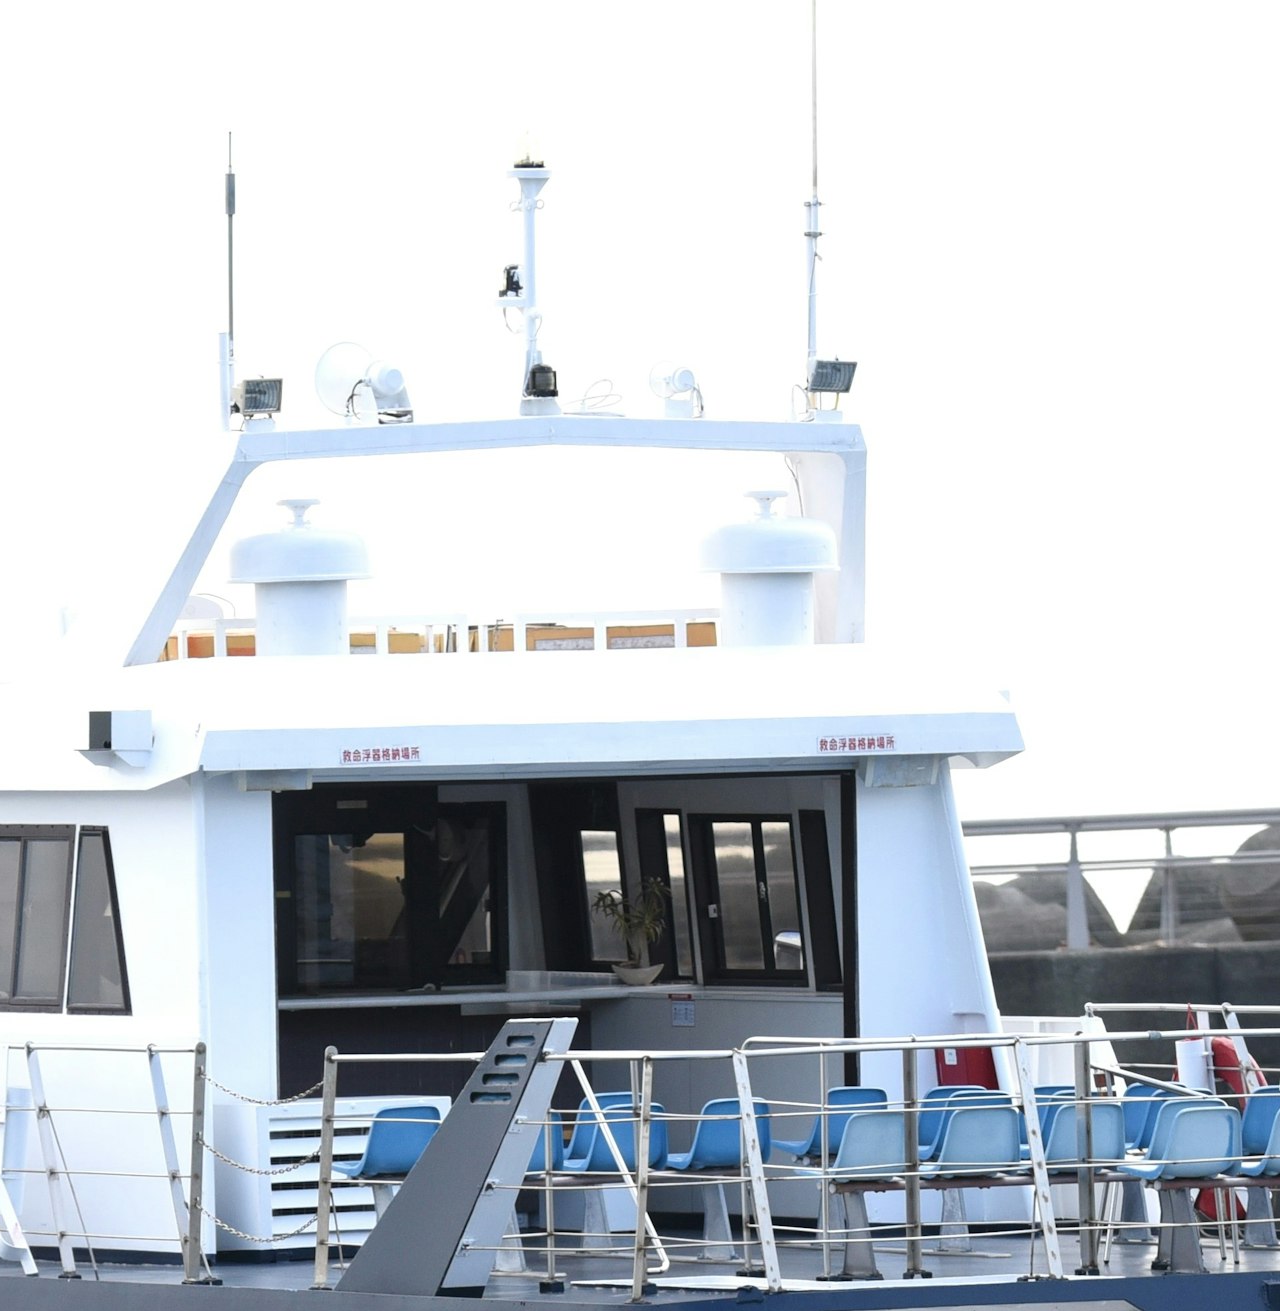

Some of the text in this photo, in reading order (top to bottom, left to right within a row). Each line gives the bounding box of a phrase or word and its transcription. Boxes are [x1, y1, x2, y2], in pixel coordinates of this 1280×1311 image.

[820, 736, 894, 752] 救命浮器格納場所
[343, 746, 420, 762] 救命浮器格納場所
